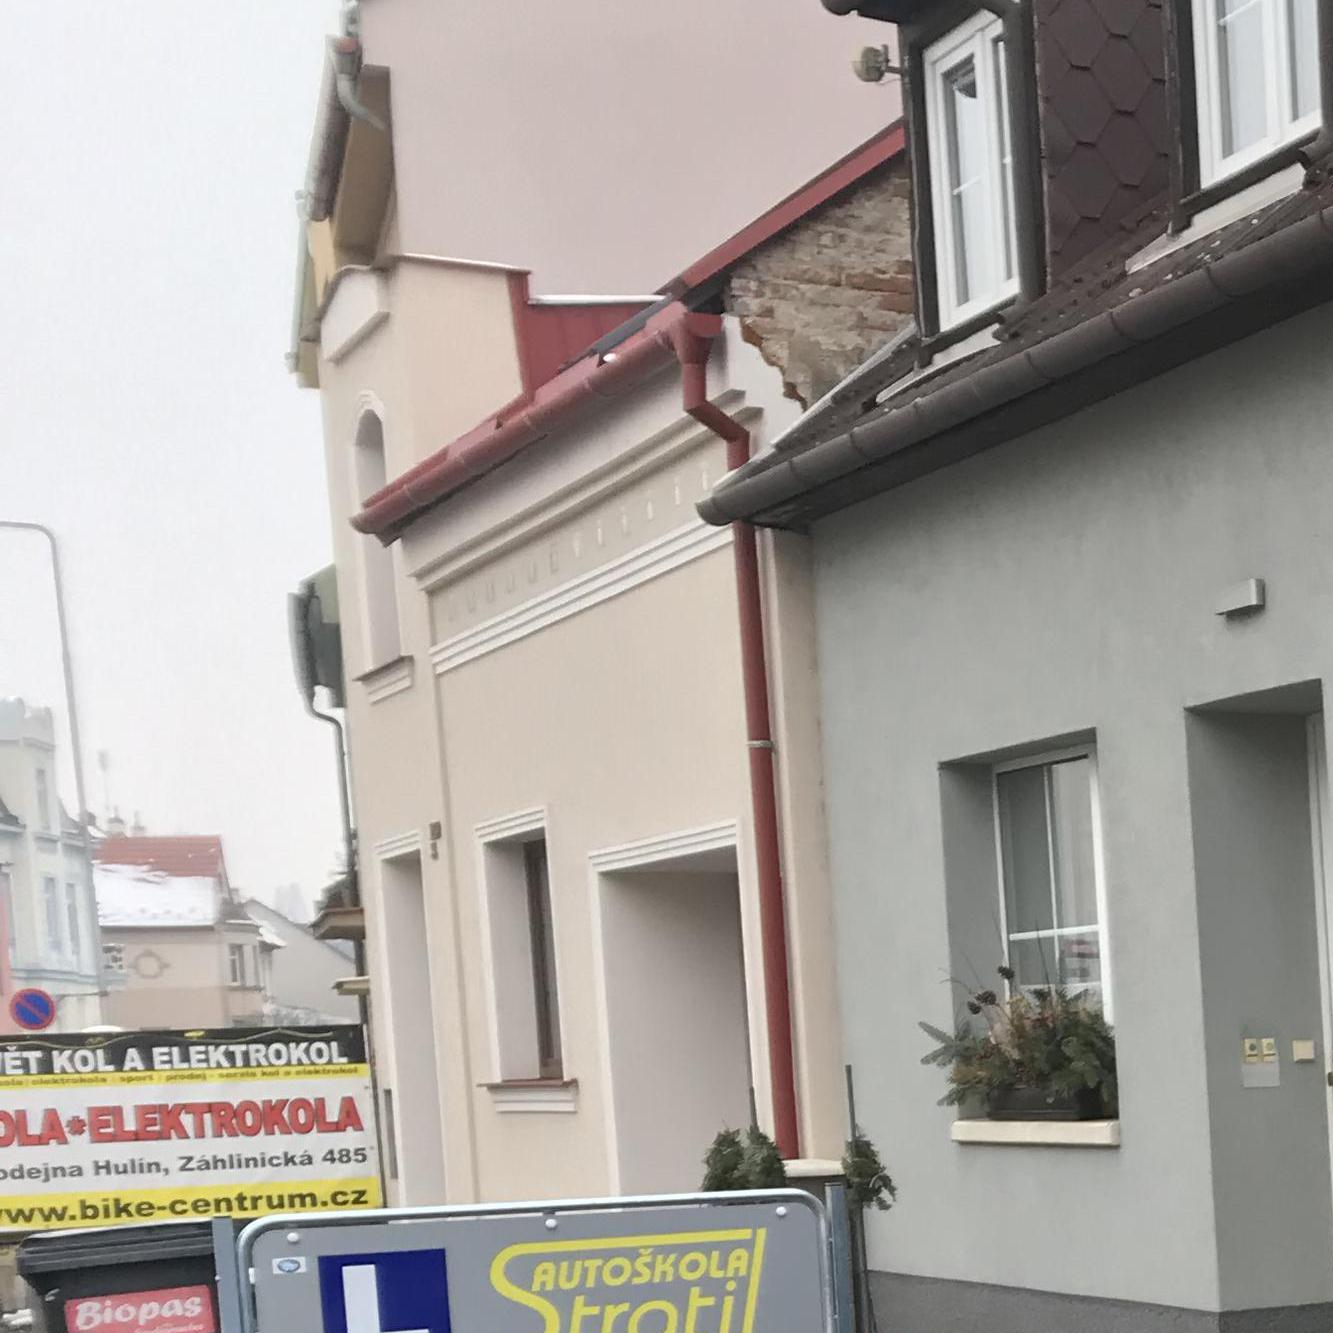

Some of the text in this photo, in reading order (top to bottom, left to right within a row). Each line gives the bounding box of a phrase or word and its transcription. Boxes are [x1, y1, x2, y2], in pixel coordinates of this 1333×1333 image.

[0, 1041, 349, 1075] ĚT KOL A ELEKTROKOL
[179, 1149, 313, 1173] Záhlinická
[322, 1147, 368, 1164] 485
[0, 1188, 369, 1225] ww.bike-centrum.cz
[532, 1245, 748, 1293] AUTOŠKOLA
[75, 1296, 202, 1331] Biopas
